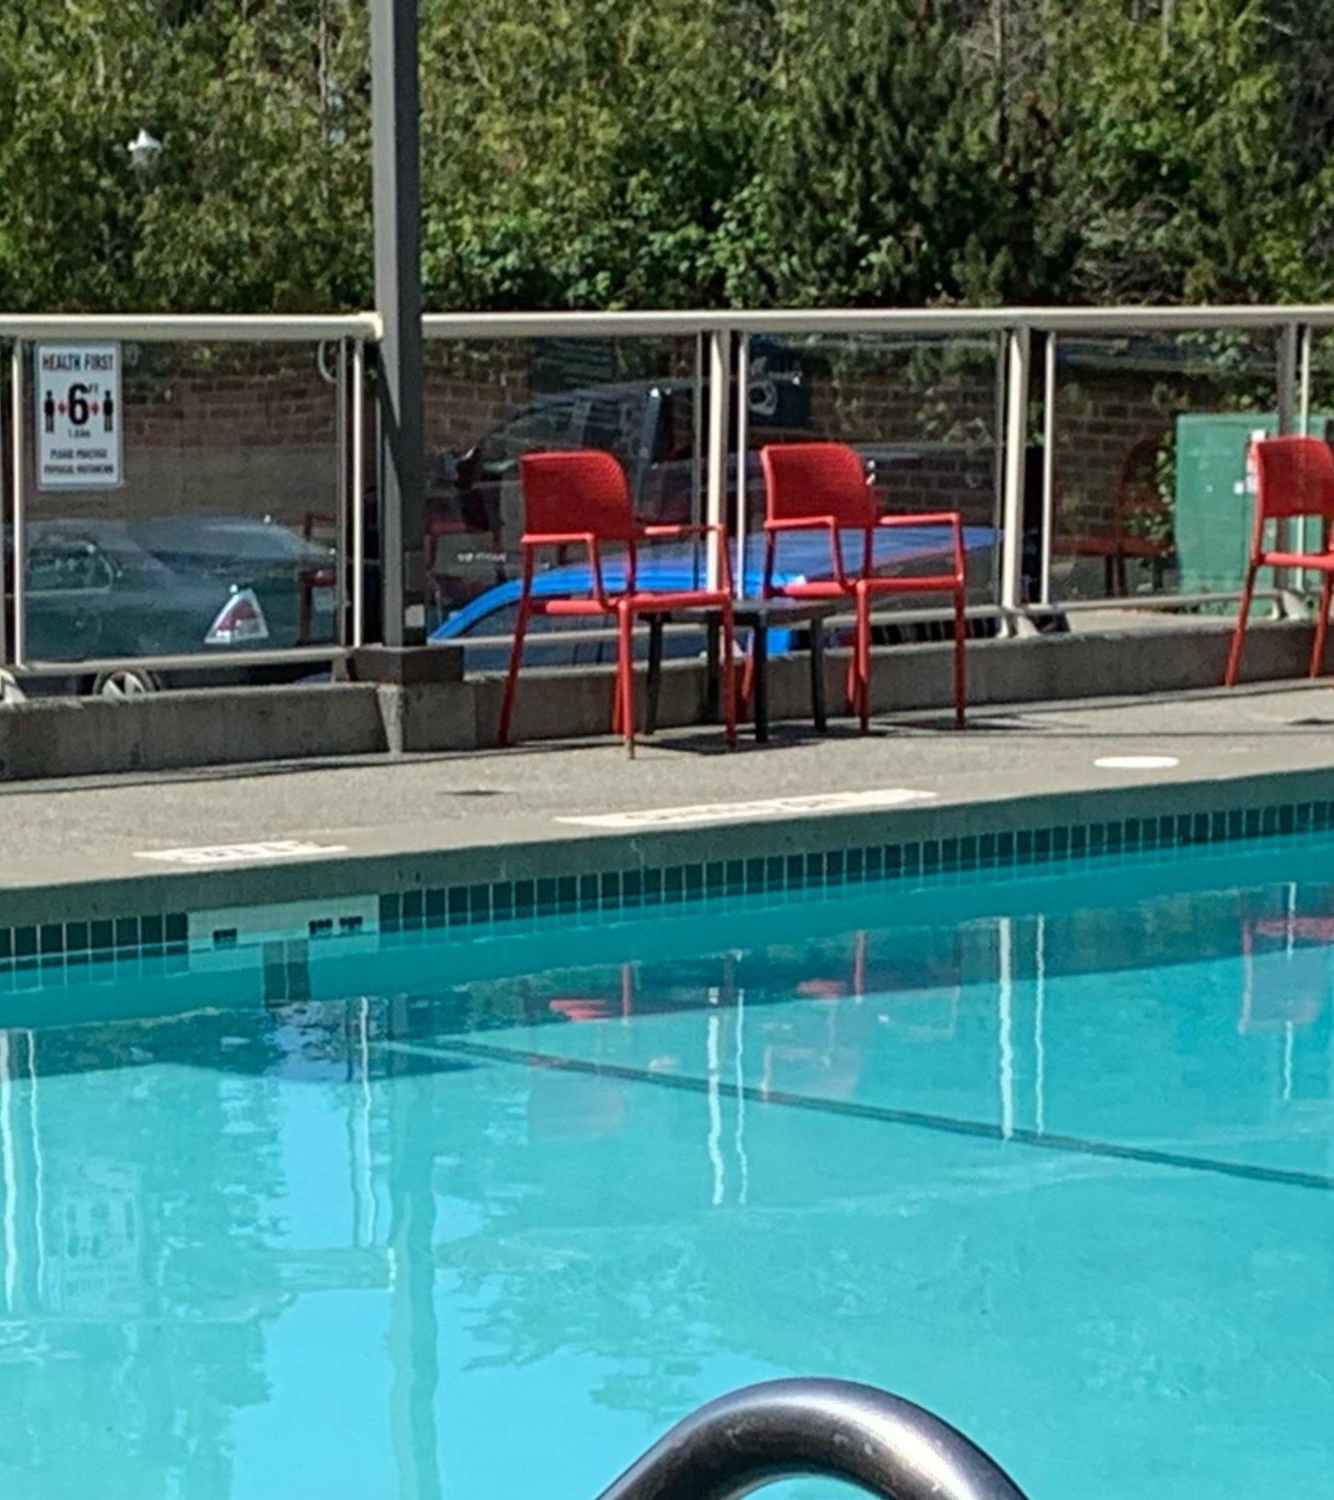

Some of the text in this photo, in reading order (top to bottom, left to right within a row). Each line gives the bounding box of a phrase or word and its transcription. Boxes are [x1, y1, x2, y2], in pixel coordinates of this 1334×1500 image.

[42, 354, 114, 371] HEALTH FIRST
[69, 383, 89, 425] 6
